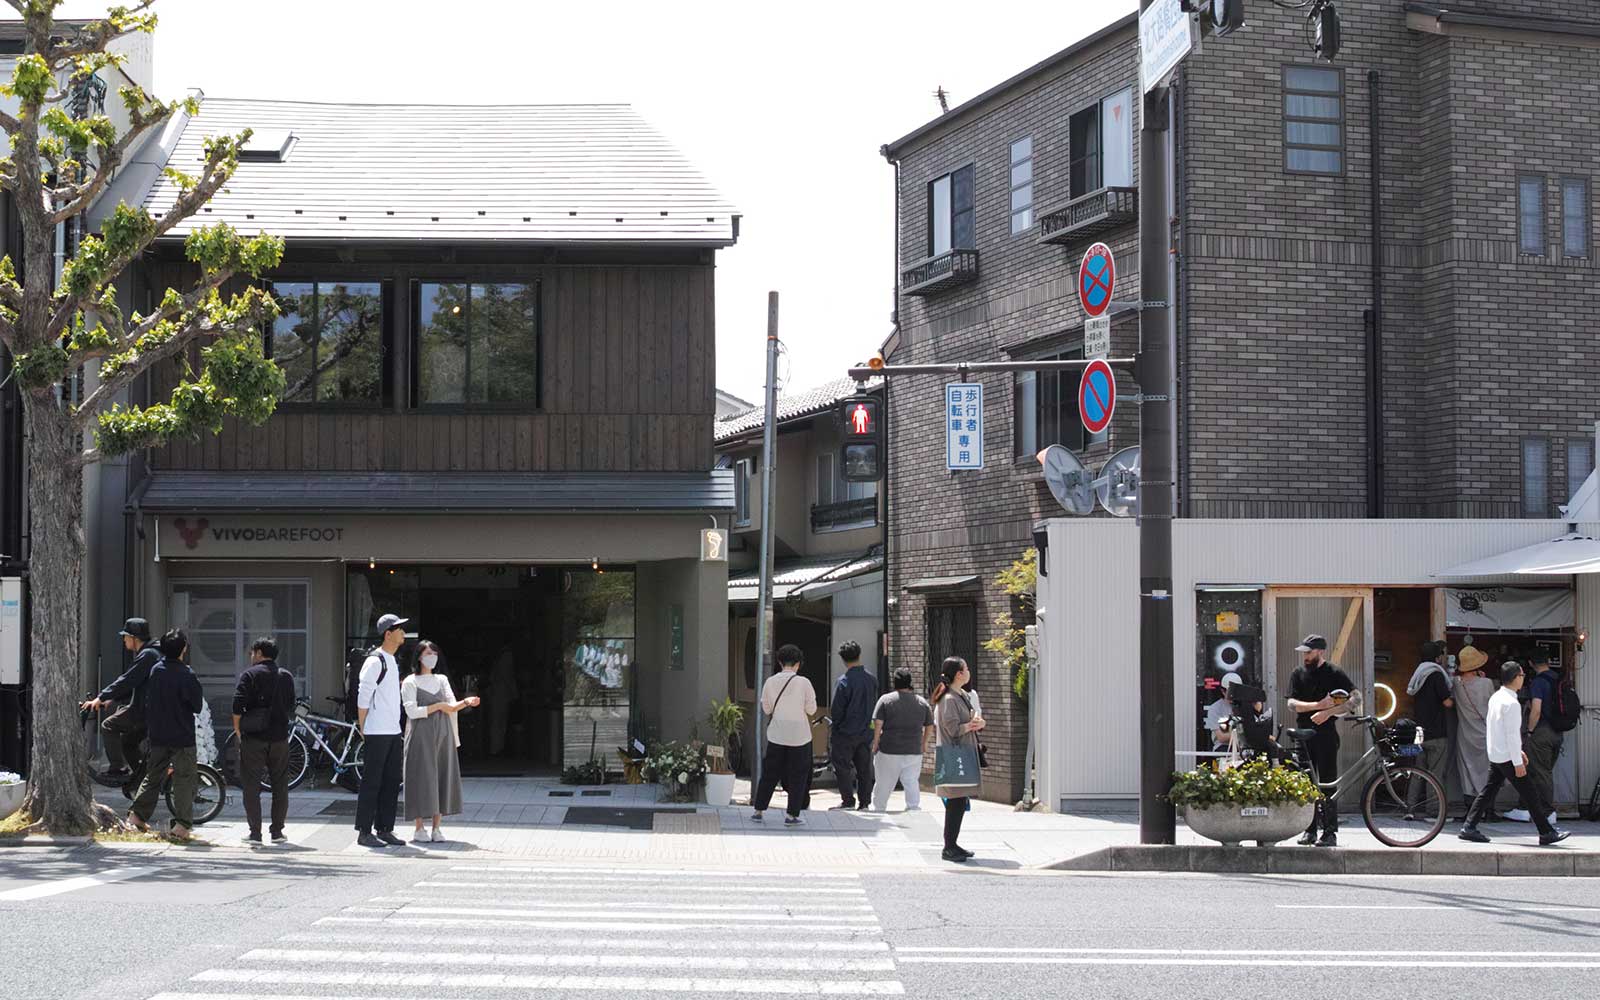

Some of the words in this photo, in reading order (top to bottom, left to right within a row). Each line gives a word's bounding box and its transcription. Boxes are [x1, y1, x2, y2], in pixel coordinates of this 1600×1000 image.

[951, 389, 963, 431] 自転車
[965, 389, 977, 431] 歩行者
[959, 434, 970, 463] 専用
[212, 528, 344, 542] VIVOBAREFOOT
